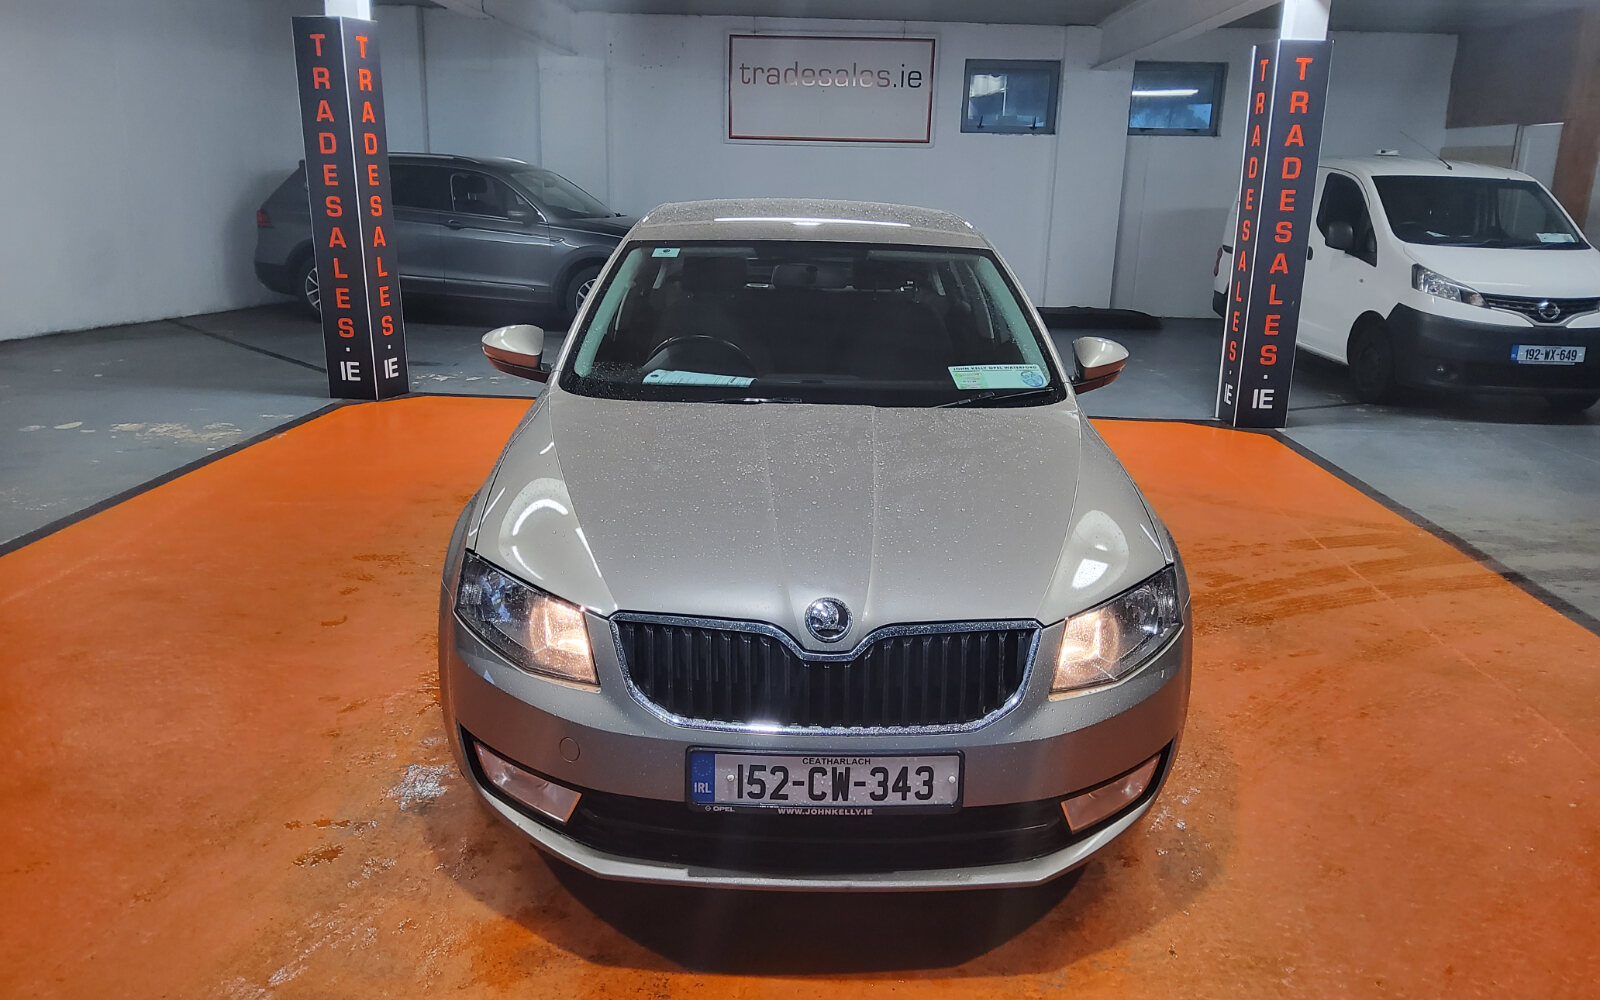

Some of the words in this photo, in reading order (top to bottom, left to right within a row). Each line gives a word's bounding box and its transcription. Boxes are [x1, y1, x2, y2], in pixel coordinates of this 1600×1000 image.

[739, 61, 922, 88] tradesales.ie
[1525, 348, 1578, 361] 192-WX-649
[802, 757, 871, 765] CEATHARLACH
[693, 782, 712, 794] IRL
[737, 764, 935, 802] 152-CW-343
[777, 807, 873, 816] WWW.JOHNKELLY.IE
